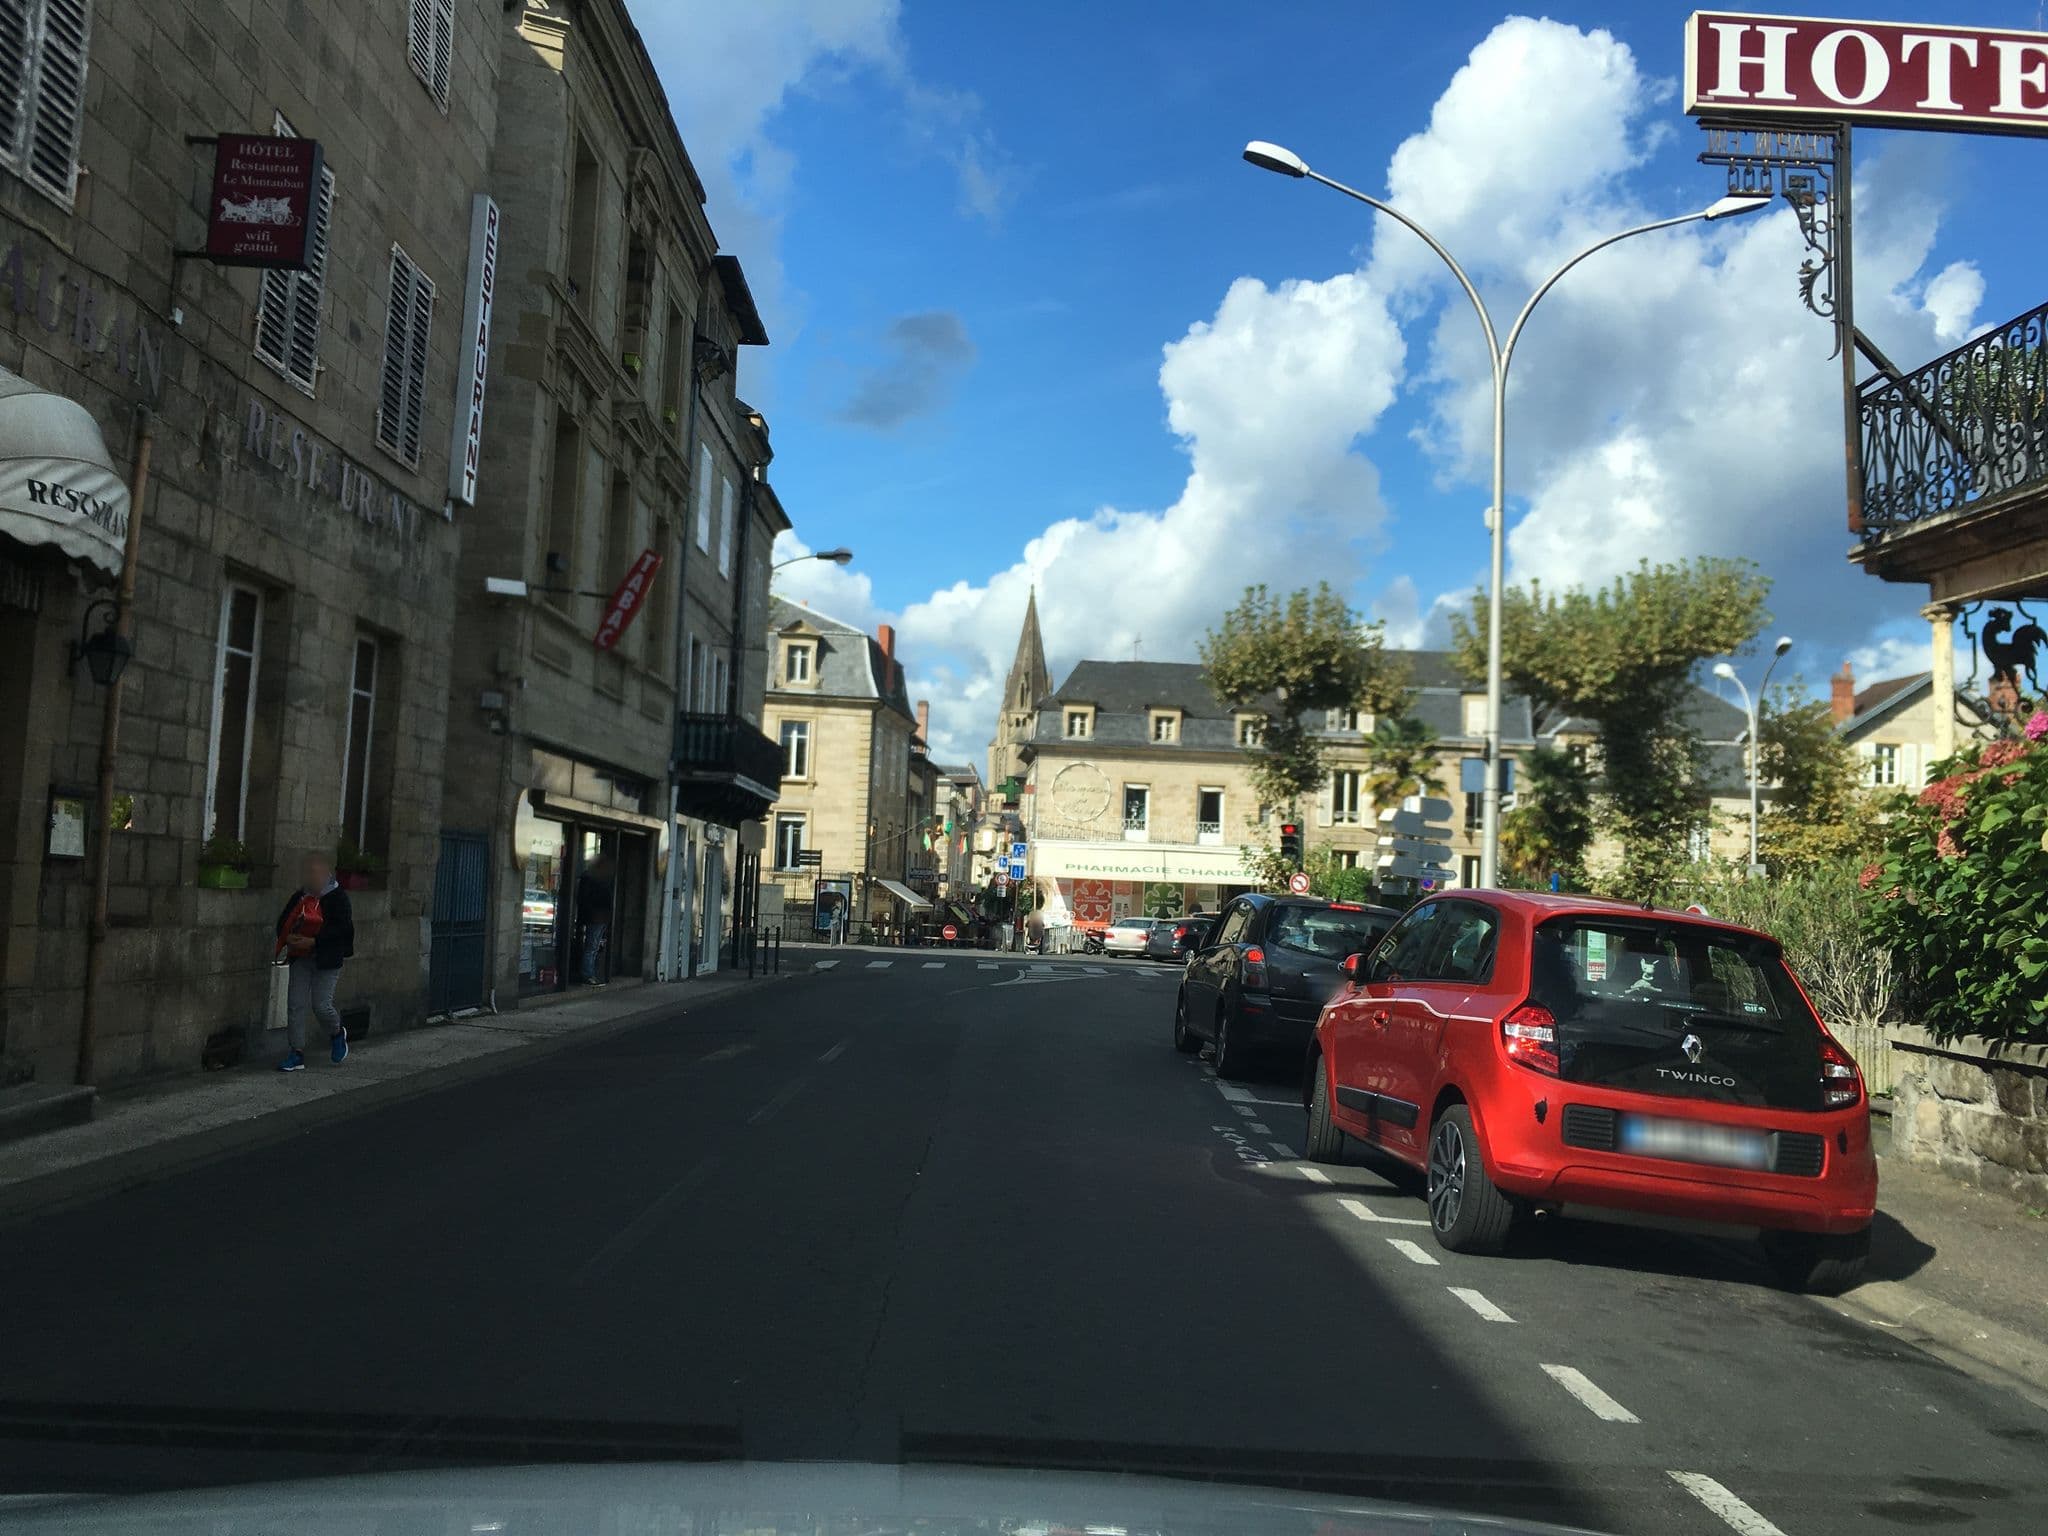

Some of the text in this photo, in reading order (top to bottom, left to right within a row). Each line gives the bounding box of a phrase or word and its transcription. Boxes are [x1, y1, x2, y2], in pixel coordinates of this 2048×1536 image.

[1707, 22, 2048, 115] HOTE
[239, 142, 295, 158] HÔTEL
[231, 158, 300, 173] Restaurant
[223, 173, 305, 189] Le Montauban
[244, 230, 272, 241] wifi
[233, 241, 280, 254] gratuit
[465, 203, 497, 498] RESTAURANT
[597, 553, 657, 648] TABAC
[1064, 863, 1172, 875] PHARMACIE
[1656, 1068, 1737, 1088] TWINGO
